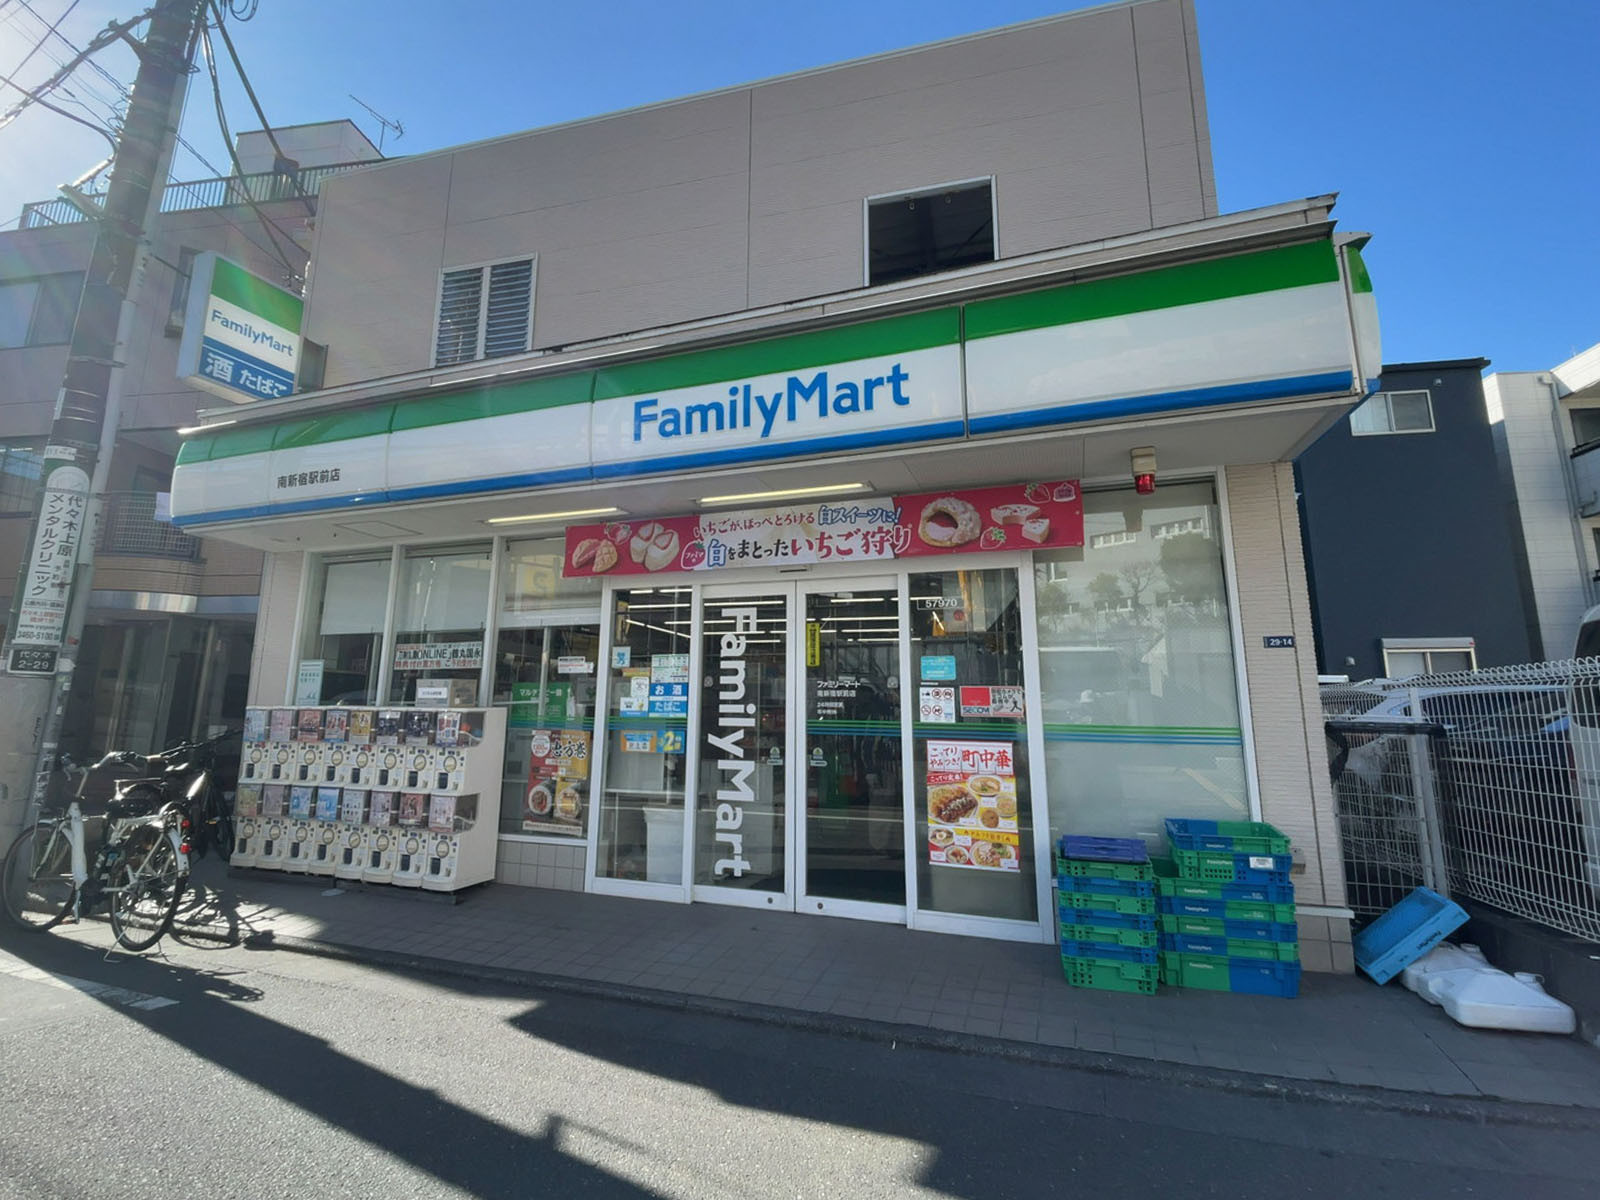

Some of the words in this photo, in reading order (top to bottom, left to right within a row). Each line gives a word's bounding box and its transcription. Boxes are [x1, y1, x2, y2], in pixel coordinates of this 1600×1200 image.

[211, 309, 293, 357] FamilyMart
[205, 352, 234, 383] 酒
[239, 369, 287, 397] たばこ
[633, 363, 910, 441] FamilyMart
[277, 468, 340, 488] 南新宿駅前店
[57, 495, 82, 557] 代々木上原
[32, 494, 64, 595] メンタルクリニック
[925, 598, 957, 608] 57970
[18, 660, 49, 670] 2-29
[20, 651, 51, 659] 代々木
[817, 680, 861, 688] ファミリーマート
[963, 706, 990, 715] SECOM
[708, 606, 758, 878] FamilyMart
[961, 749, 1011, 769] 町中華
